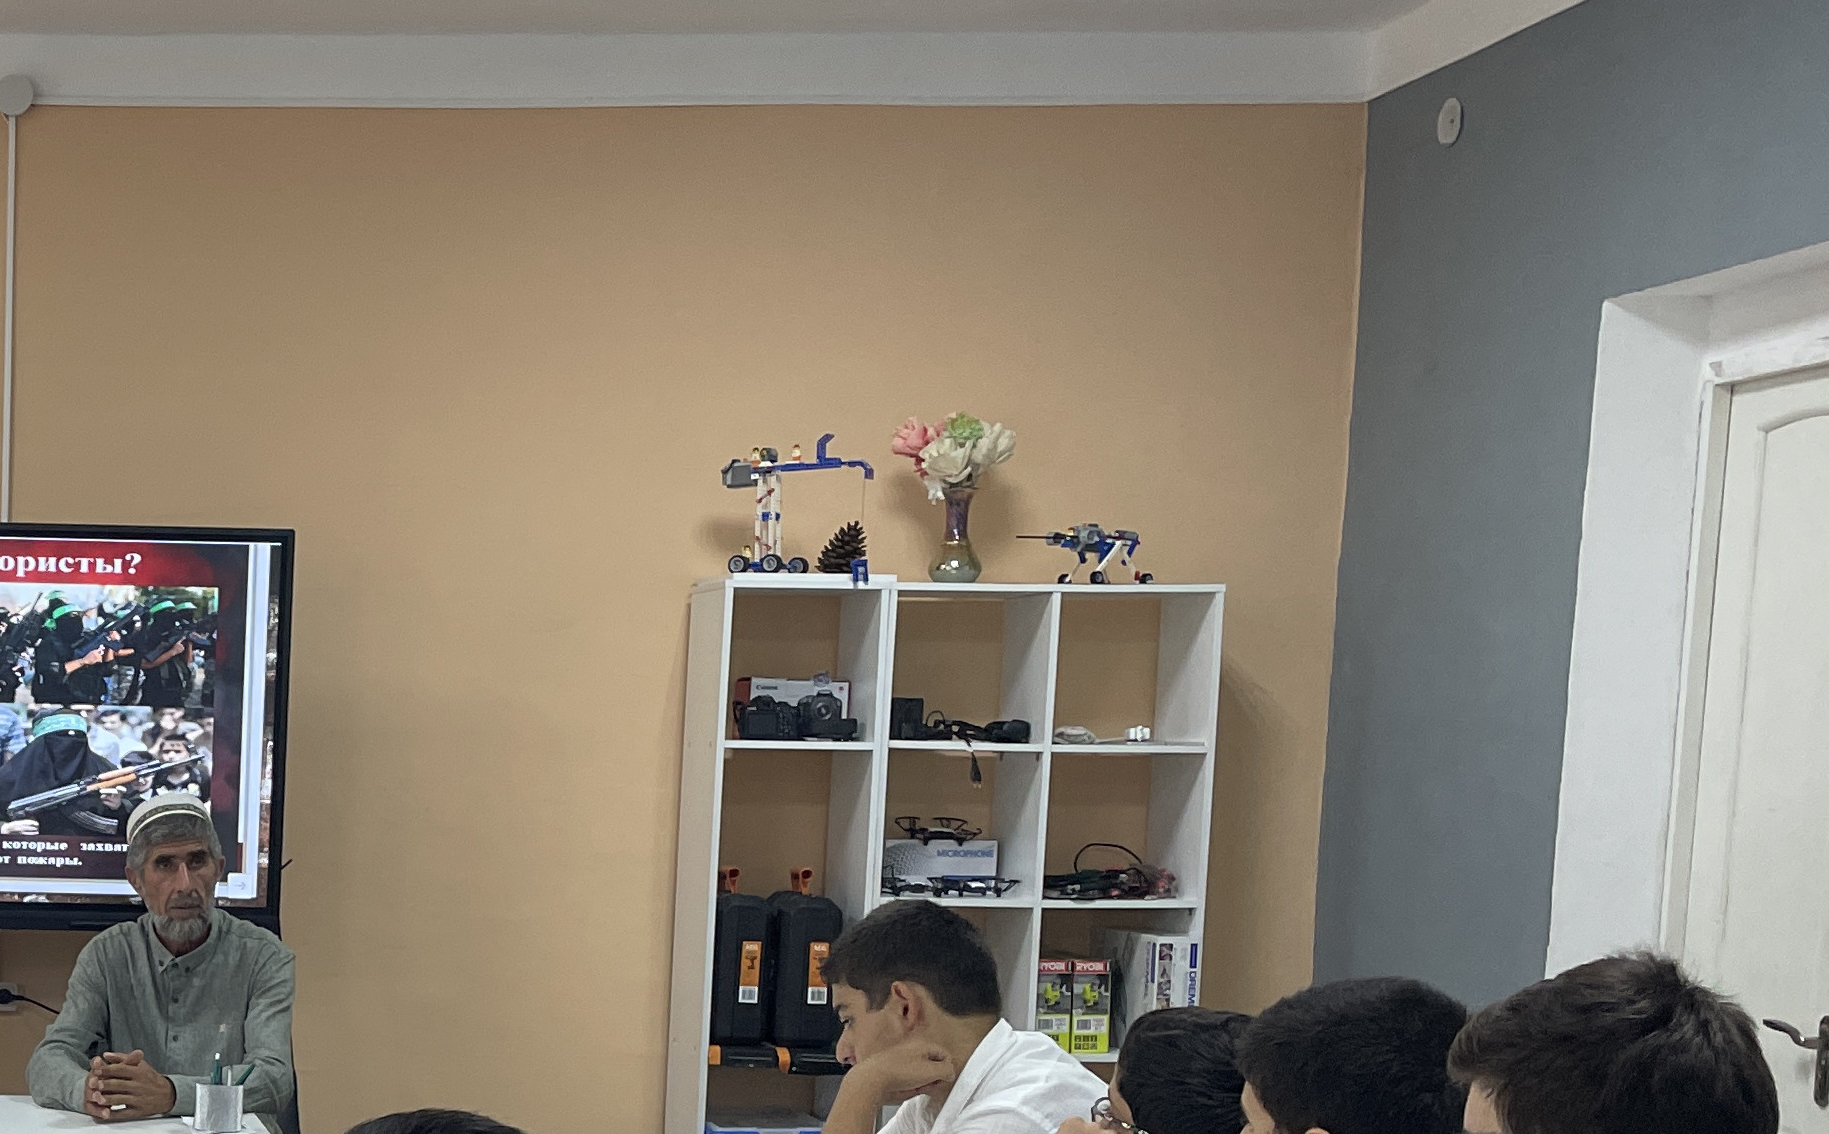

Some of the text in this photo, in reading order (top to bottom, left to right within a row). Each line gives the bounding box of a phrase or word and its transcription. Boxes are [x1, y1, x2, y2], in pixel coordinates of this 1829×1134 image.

[1, 840, 69, 853] которые
[79, 842, 130, 853] захват
[936, 849, 995, 858] MICROPHONE
[16, 855, 83, 868] пожары.
